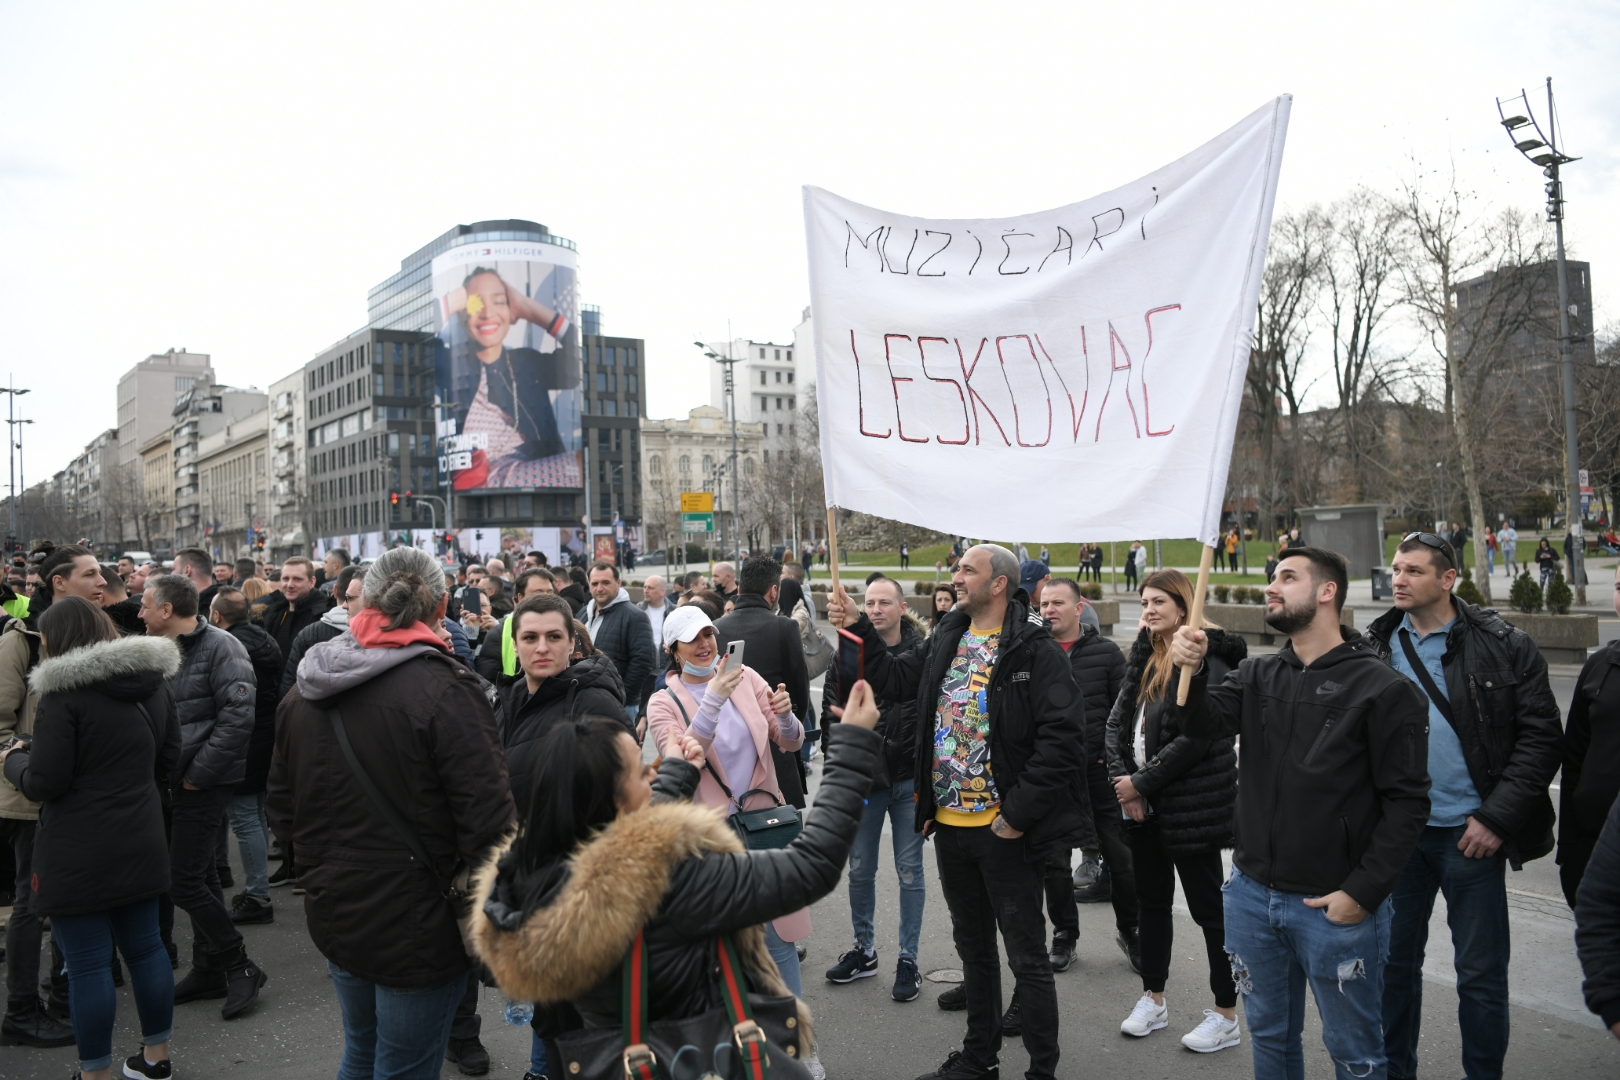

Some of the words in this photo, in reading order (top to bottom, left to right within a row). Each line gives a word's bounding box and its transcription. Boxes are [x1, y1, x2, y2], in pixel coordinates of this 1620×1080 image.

[494, 247, 543, 257] HILFIGER
[850, 303, 1182, 448] LESKOVAC
[944, 741, 955, 750] GO
